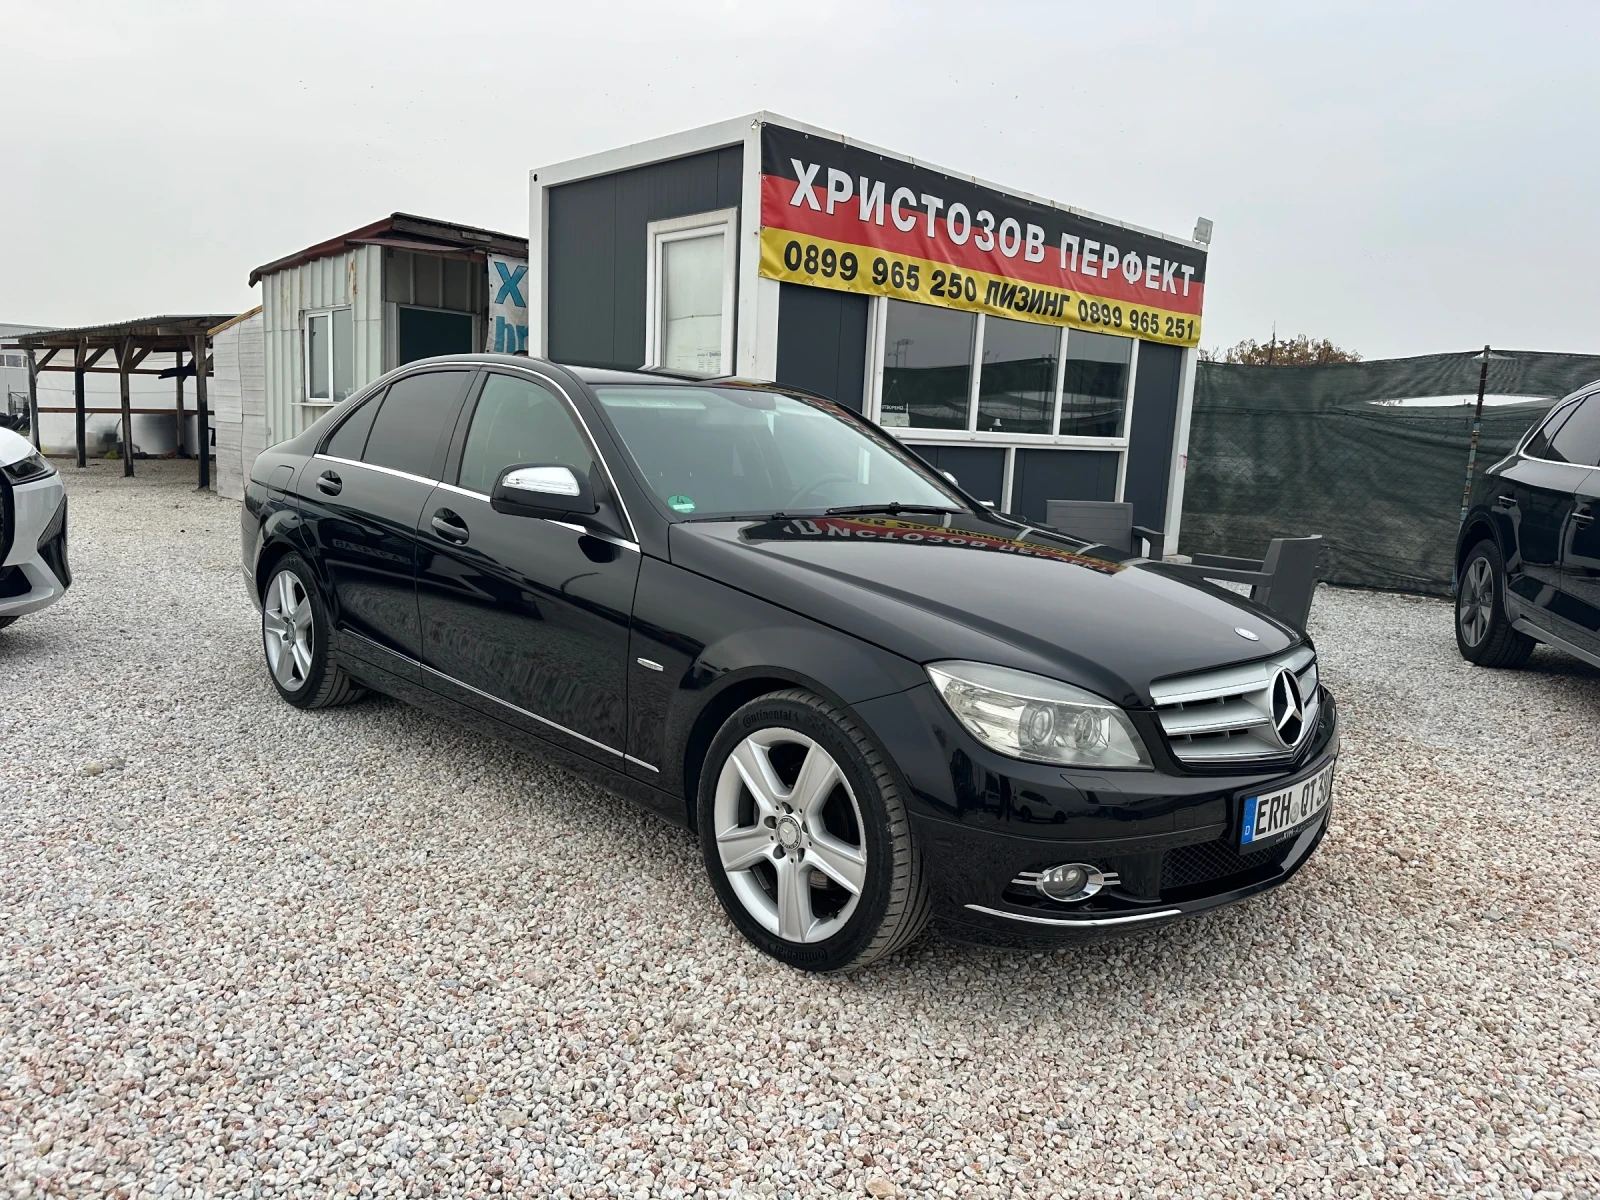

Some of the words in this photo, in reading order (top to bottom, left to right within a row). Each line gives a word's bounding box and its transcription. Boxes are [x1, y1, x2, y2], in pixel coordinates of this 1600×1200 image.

[788, 157, 1046, 263] ХРИСТОЗОВ
[1060, 232, 1195, 297] ПЕРФЕКТ
[784, 240, 859, 281] 0899
[872, 257, 920, 292] 965
[929, 269, 977, 301] 250
[984, 279, 1070, 317] ЛИЗИНГ
[1078, 299, 1123, 328] 0899
[1129, 309, 1160, 335] 965
[1165, 316, 1194, 340] 251
[743, 709, 792, 729] Continental
[1244, 825, 1251, 835] D
[1255, 791, 1293, 836] ERH
[1300, 778, 1317, 817] QT
